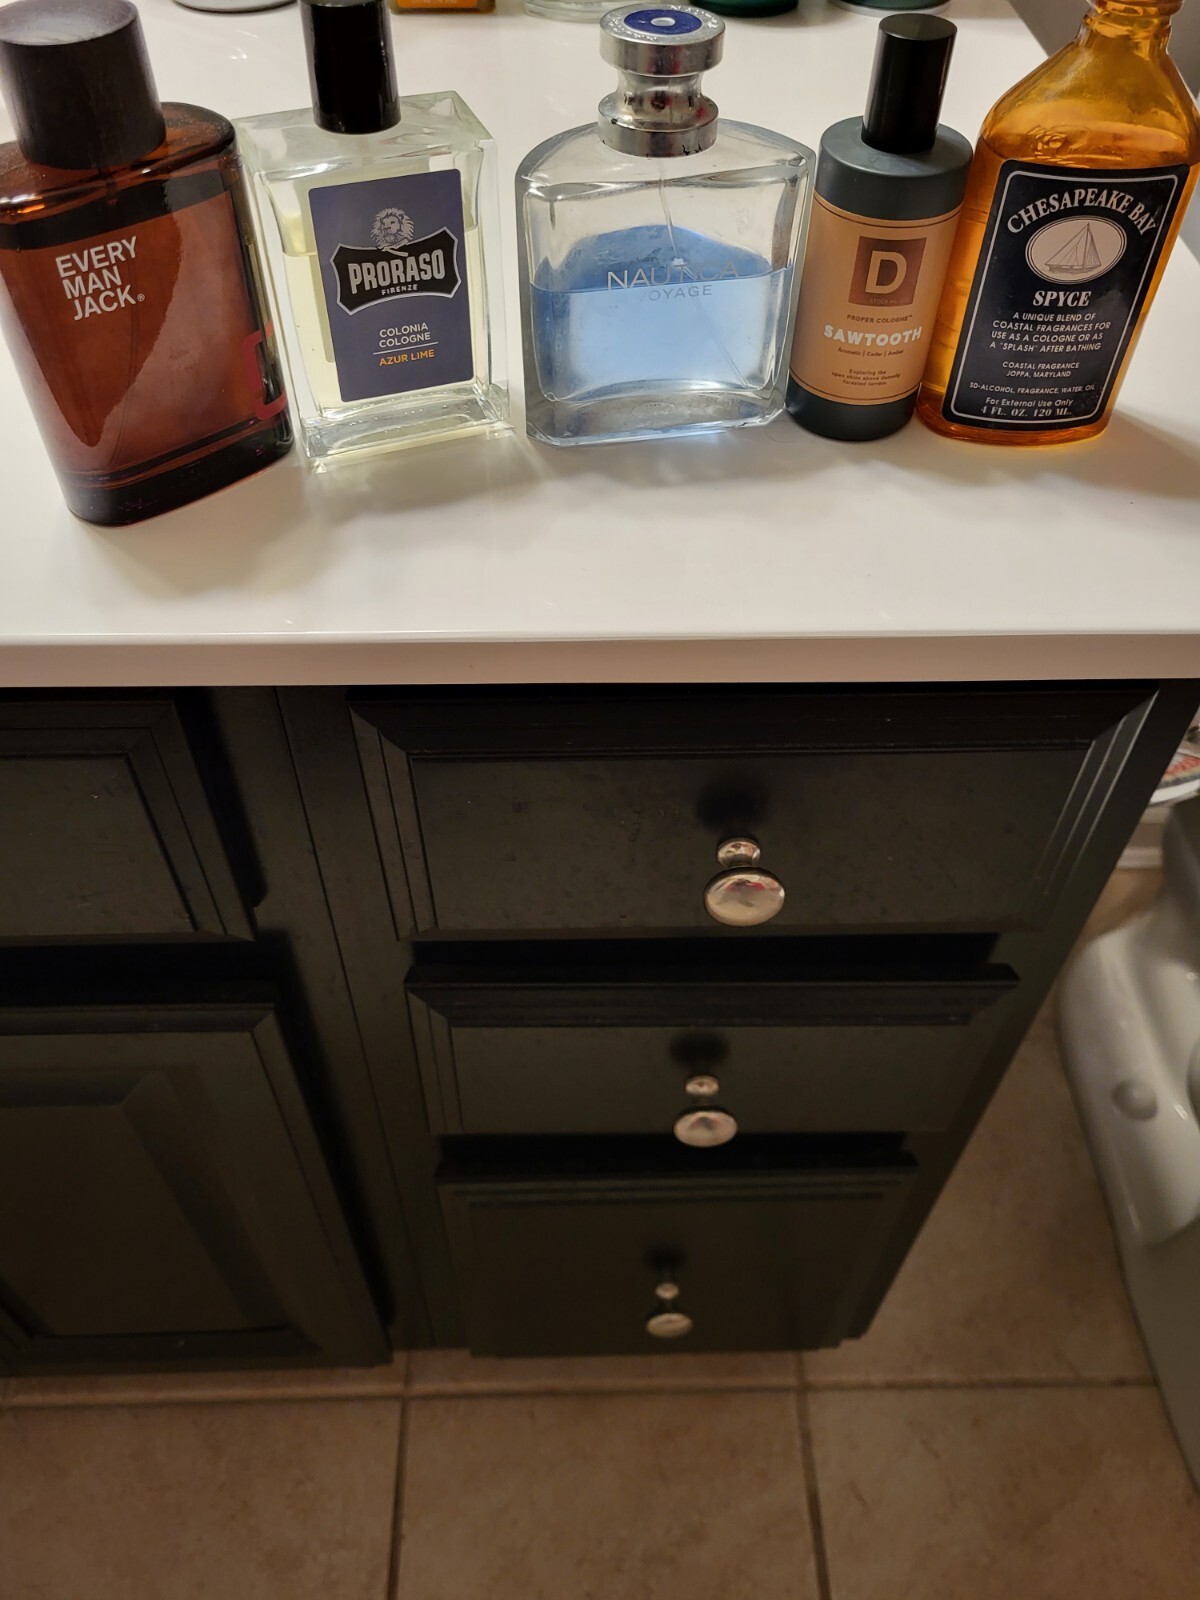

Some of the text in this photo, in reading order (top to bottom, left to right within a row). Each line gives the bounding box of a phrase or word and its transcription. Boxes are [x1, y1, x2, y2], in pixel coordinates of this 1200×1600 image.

[1007, 188, 1156, 236] CHESAPEAKE BAY
[56, 236, 137, 278] EVERY
[347, 248, 446, 295] PRORASO
[865, 250, 907, 294] D
[62, 265, 122, 299] MAN
[381, 284, 418, 296] FIRENZE
[1032, 290, 1092, 307] SPYCE
[846, 314, 874, 323] PROPER
[1022, 313, 1054, 322] UNIQUE
[1056, 313, 1082, 322] BLEND
[1084, 313, 1096, 321] OF
[379, 322, 429, 338] COLONIA
[992, 320, 1111, 332] COASTAL FRAGRANCES FOR
[378, 332, 432, 348] COLOGNE
[823, 324, 923, 346] SAWTOOTH
[991, 331, 1007, 340] USE
[1008, 333, 1021, 341] AS
[1032, 334, 1076, 342] COLOGNE
[1078, 334, 1090, 342] OR
[989, 341, 996, 349] A
[1039, 345, 1065, 353] AFTER
[1066, 343, 1101, 352] BATHING
[379, 349, 435, 366] AZUR LIME
[1002, 361, 1080, 370] COASTAL FRAGRANCE
[1006, 370, 1032, 378] JOPPA,
[985, 397, 998, 405] For
[1001, 399, 1036, 407] External
[1054, 399, 1074, 407] Only
[1011, 408, 1028, 417] OZ.
[1033, 408, 1052, 417] 120
